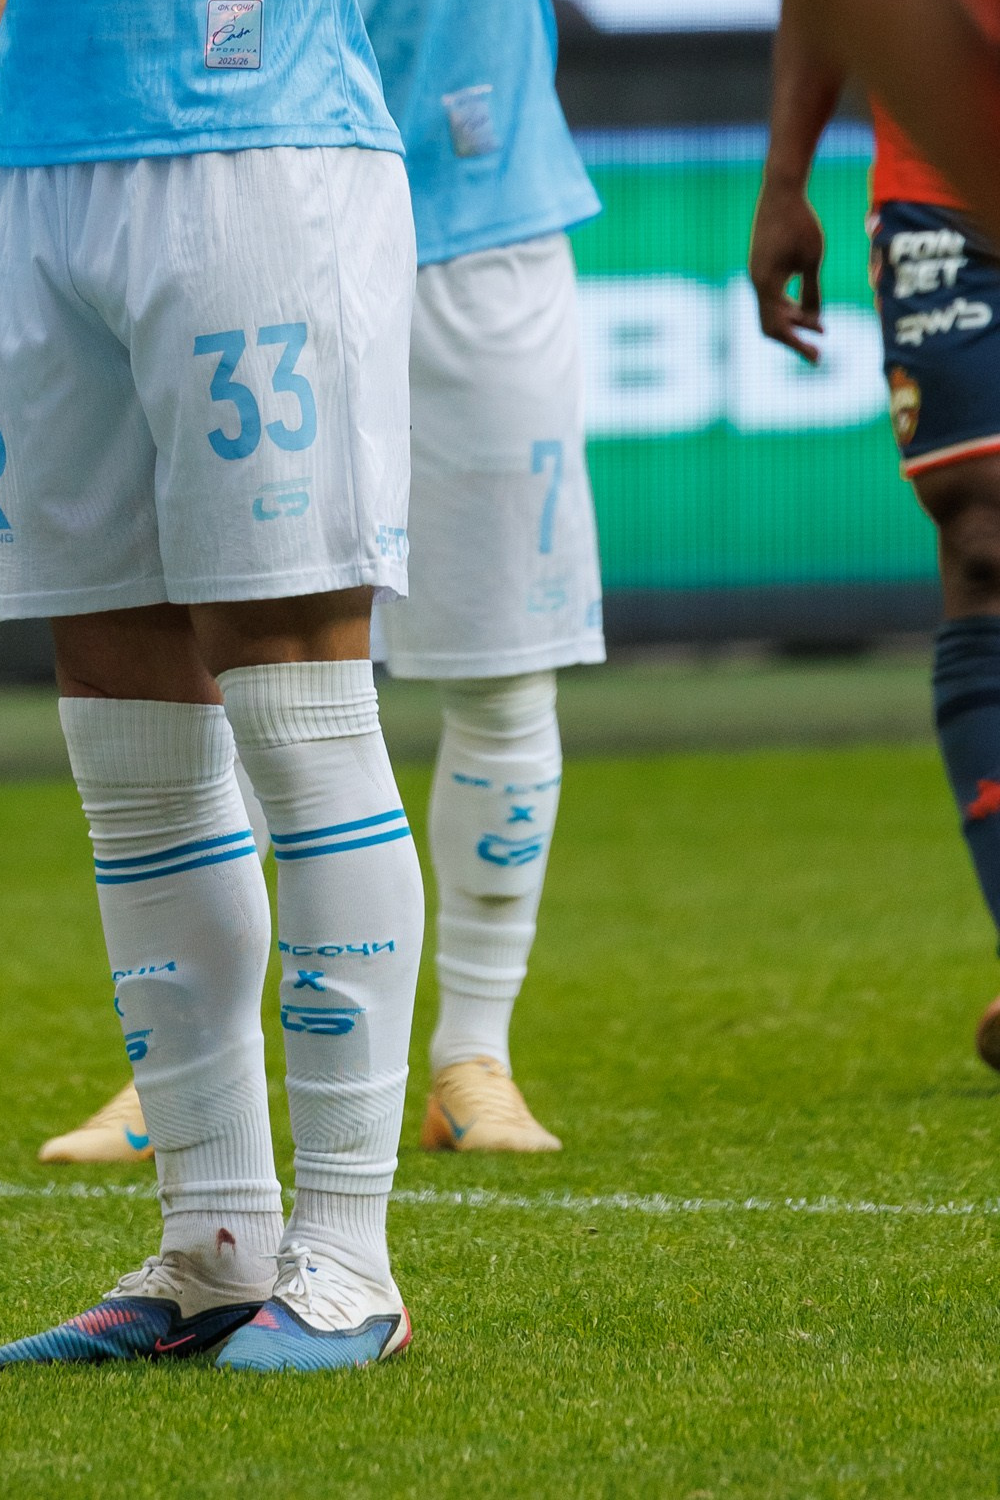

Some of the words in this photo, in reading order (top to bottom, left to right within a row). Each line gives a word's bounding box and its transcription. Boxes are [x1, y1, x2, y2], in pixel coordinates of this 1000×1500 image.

[218, 56, 250, 66] 2025/26
[193, 322, 318, 461] 33
[531, 440, 564, 555] 7
